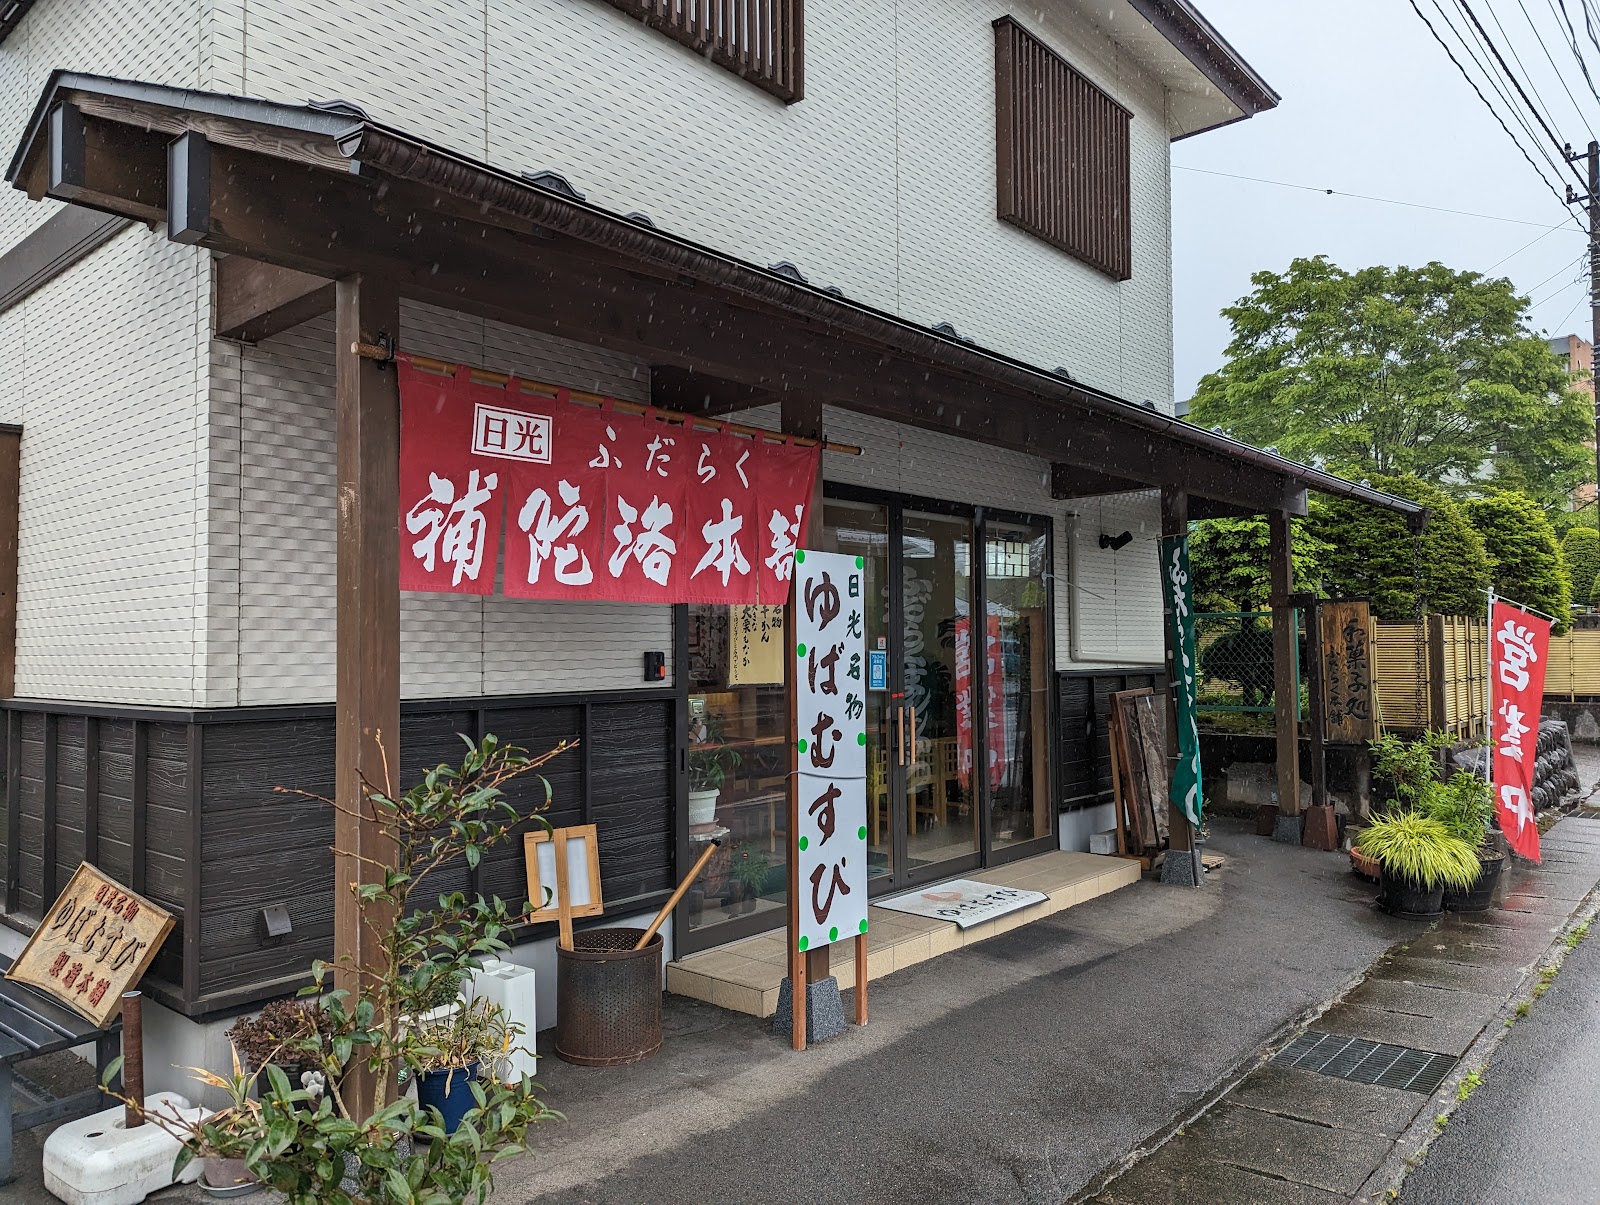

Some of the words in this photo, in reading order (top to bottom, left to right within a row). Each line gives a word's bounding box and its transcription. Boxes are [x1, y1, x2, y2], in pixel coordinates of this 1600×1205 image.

[483, 415, 543, 455] 日光
[589, 425, 750, 489] ふだらく
[845, 574, 864, 721] 日光名物
[804, 571, 850, 925] ゆばむすび
[50, 897, 146, 971] ゆばむすび
[94, 883, 140, 923] 日光名物
